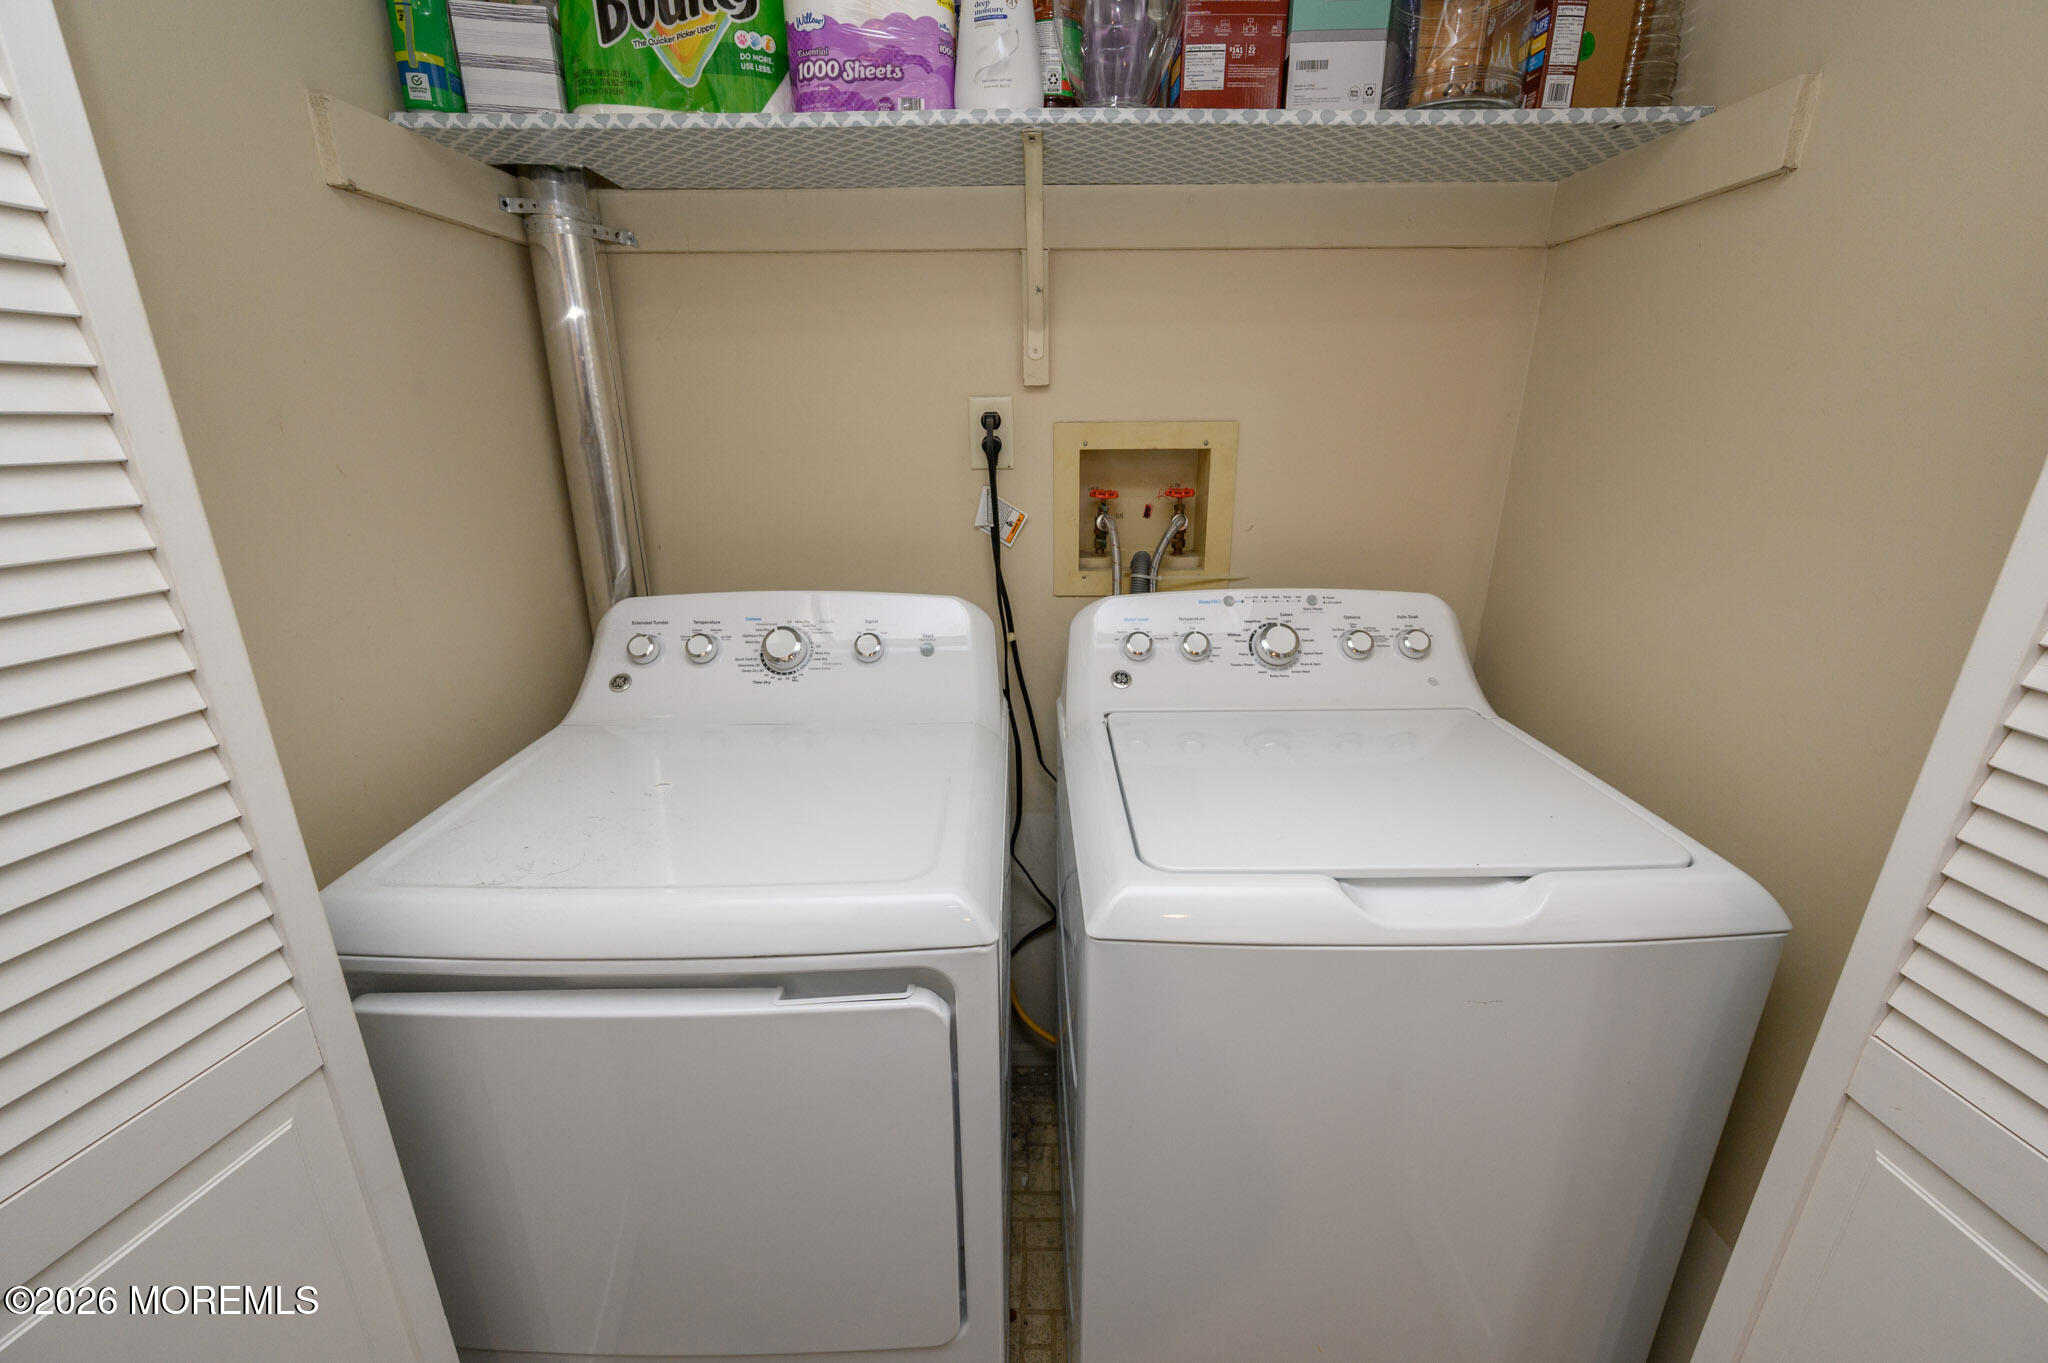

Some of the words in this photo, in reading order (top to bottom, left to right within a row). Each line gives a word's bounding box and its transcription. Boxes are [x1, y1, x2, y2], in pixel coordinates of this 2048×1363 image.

[974, 7, 1004, 15] moisture
[648, 36, 675, 46] Quicker
[676, 29, 696, 40] Picker
[697, 24, 717, 35] Upper
[797, 47, 829, 57] Essential
[1248, 46, 1256, 54] 22
[740, 53, 751, 61] DO
[741, 62, 754, 70] USE
[798, 60, 840, 80] 1000
[842, 60, 903, 82] Sheets
